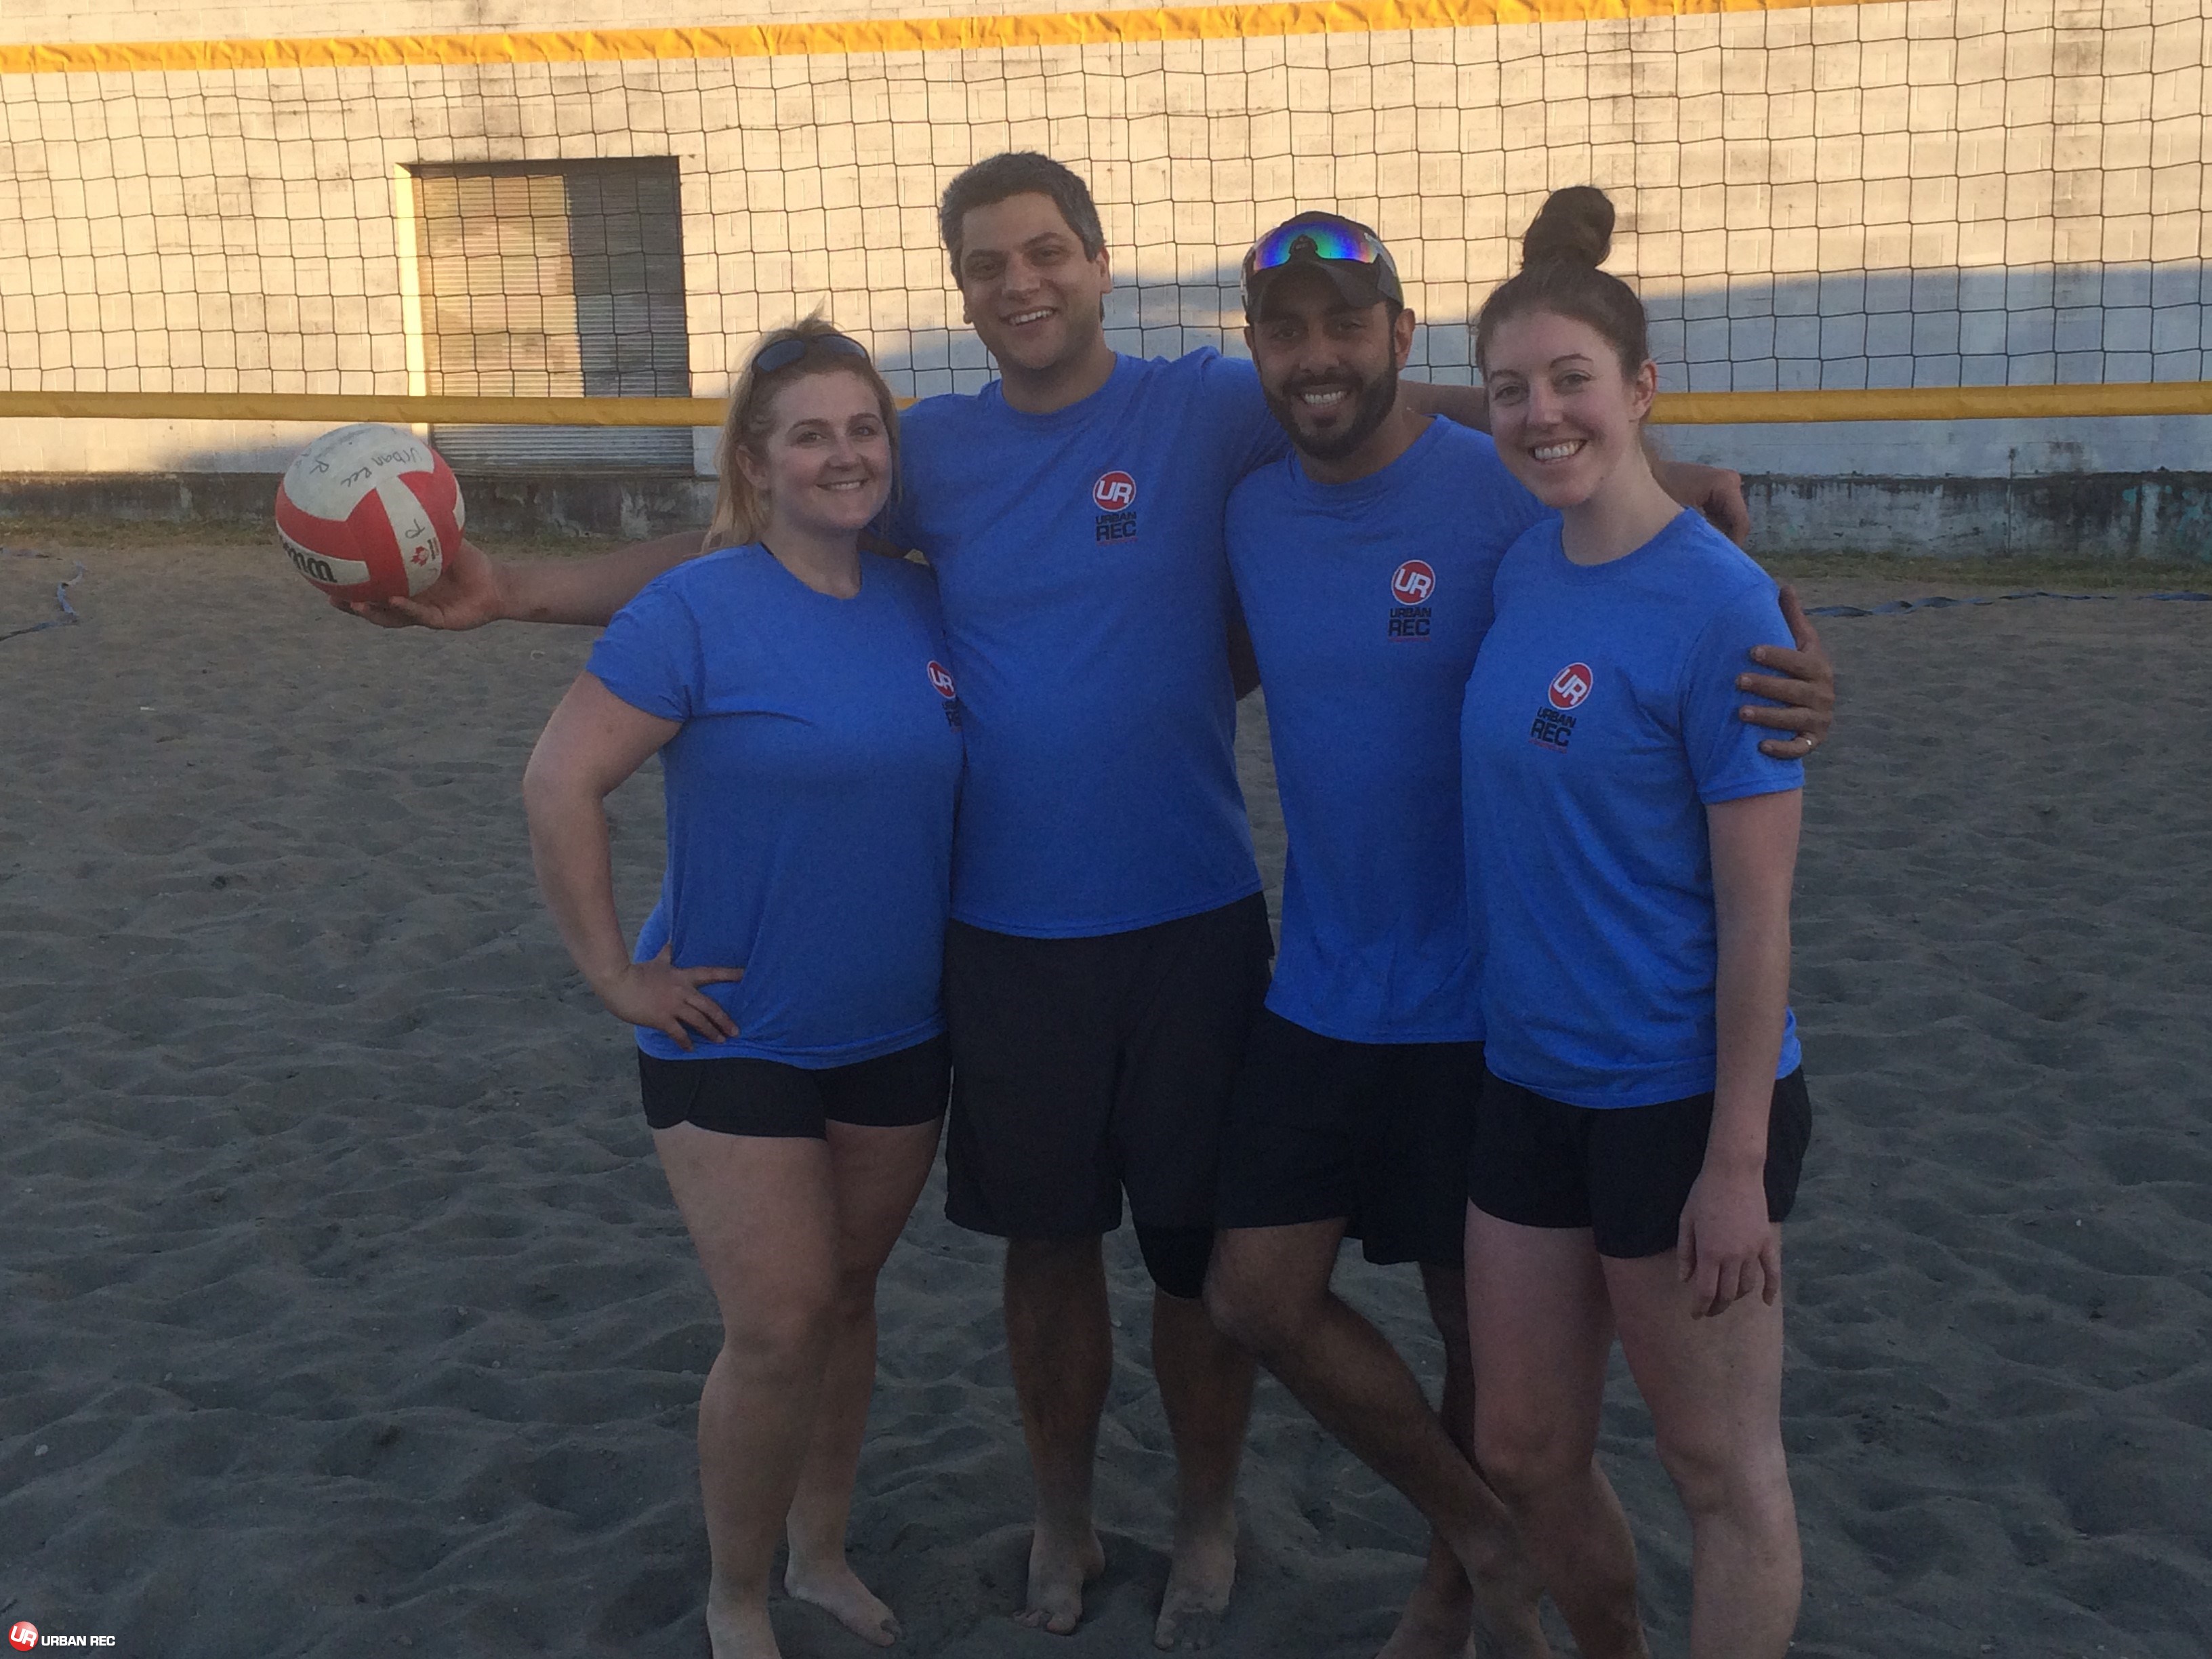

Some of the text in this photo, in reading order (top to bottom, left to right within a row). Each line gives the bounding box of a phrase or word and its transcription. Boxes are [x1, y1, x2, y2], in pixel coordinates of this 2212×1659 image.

[340, 447, 422, 487] Urban Rec
[1097, 480, 1132, 504] UR
[1095, 511, 1136, 525] URBAN
[1096, 520, 1136, 541] REC
[1395, 568, 1431, 598] UR
[1390, 607, 1431, 618] URBAN
[1388, 618, 1431, 636] REC
[1553, 668, 1587, 705] UR
[1537, 705, 1577, 729] URBAN
[1531, 718, 1572, 747] REC
